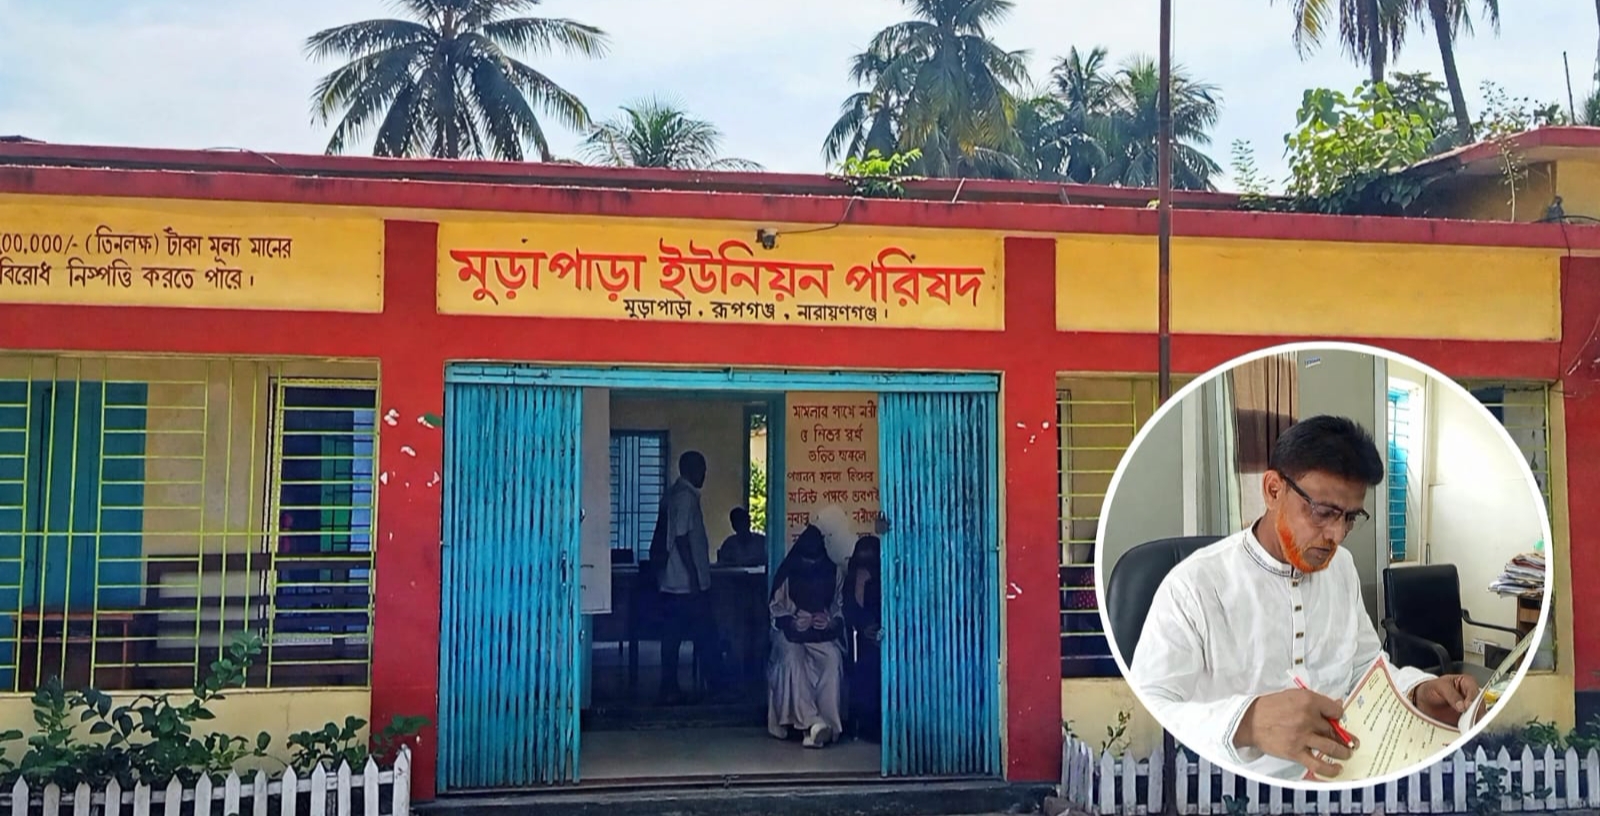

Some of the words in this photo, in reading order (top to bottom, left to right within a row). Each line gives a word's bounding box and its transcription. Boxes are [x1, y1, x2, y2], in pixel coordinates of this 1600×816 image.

[163, 226, 203, 256] টাকা
[208, 236, 241, 265] মূল্য
[248, 237, 292, 258] মানের
[0, 256, 52, 285] বিরোধ
[141, 267, 196, 289] করতে
[450, 248, 647, 305] মুড়াপাড়া
[658, 238, 834, 301] ইউনিয়ন
[846, 247, 985, 307] পরিষদ
